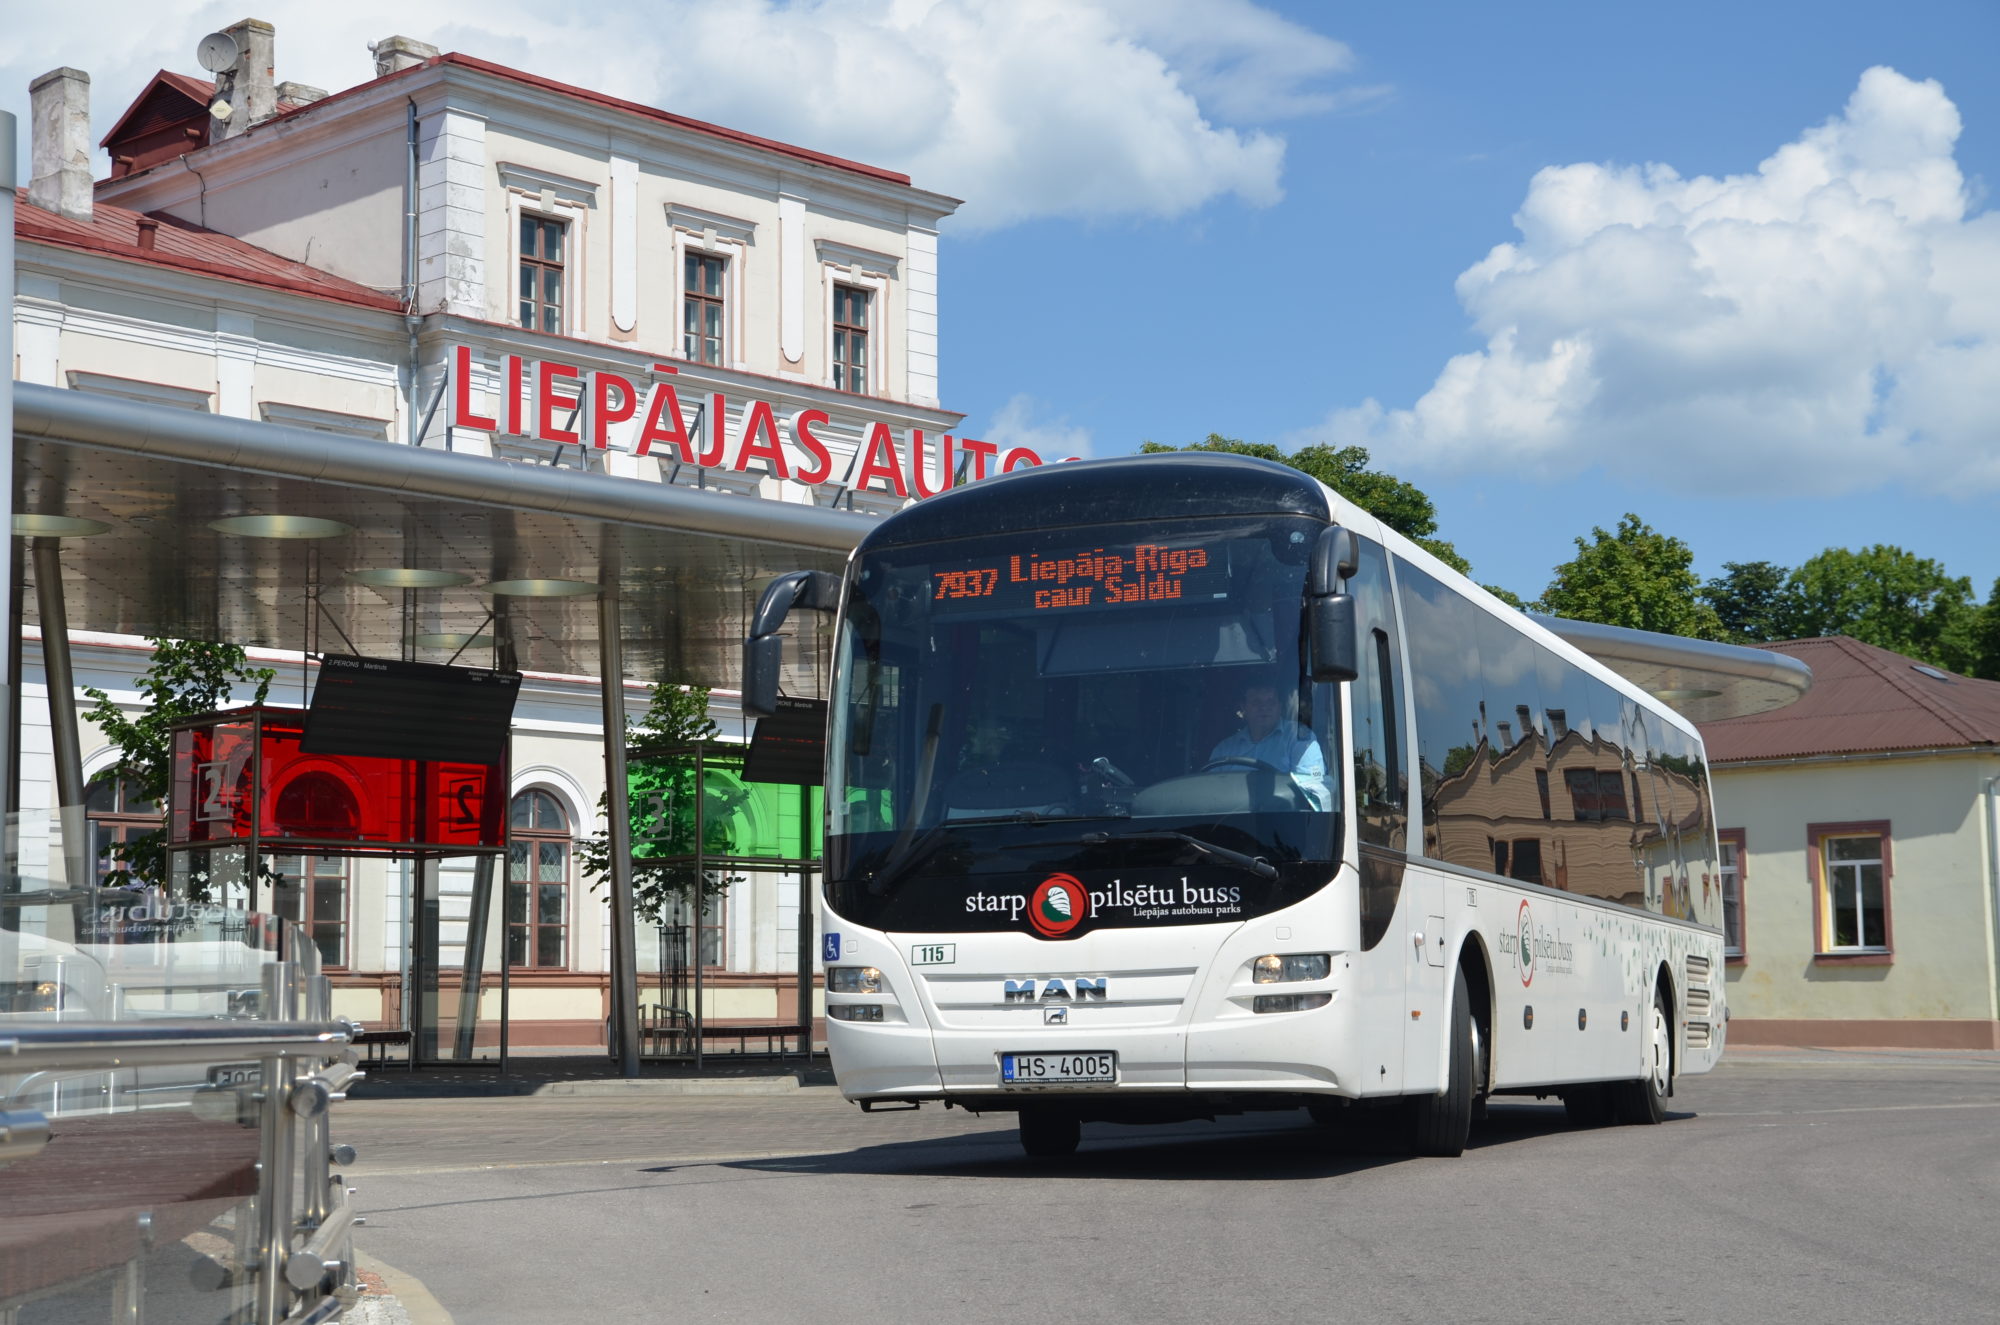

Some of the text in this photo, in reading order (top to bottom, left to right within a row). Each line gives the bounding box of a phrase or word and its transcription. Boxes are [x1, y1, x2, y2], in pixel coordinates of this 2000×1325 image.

[449, 344, 829, 484] LIEPĀJAS
[1010, 544, 1207, 584] Liepāja-Rīga
[935, 568, 998, 599] 7937
[1035, 571, 1182, 609] caur Saldu
[204, 769, 222, 813] 2
[647, 796, 664, 834] 3
[965, 876, 1241, 921] starp pilsētu buss
[1133, 903, 1242, 920] Liepājas autobusu parks
[921, 946, 945, 963] 115
[1498, 927, 1518, 969] starp
[1556, 927, 1573, 961] buss
[1003, 976, 1108, 1004] MAN
